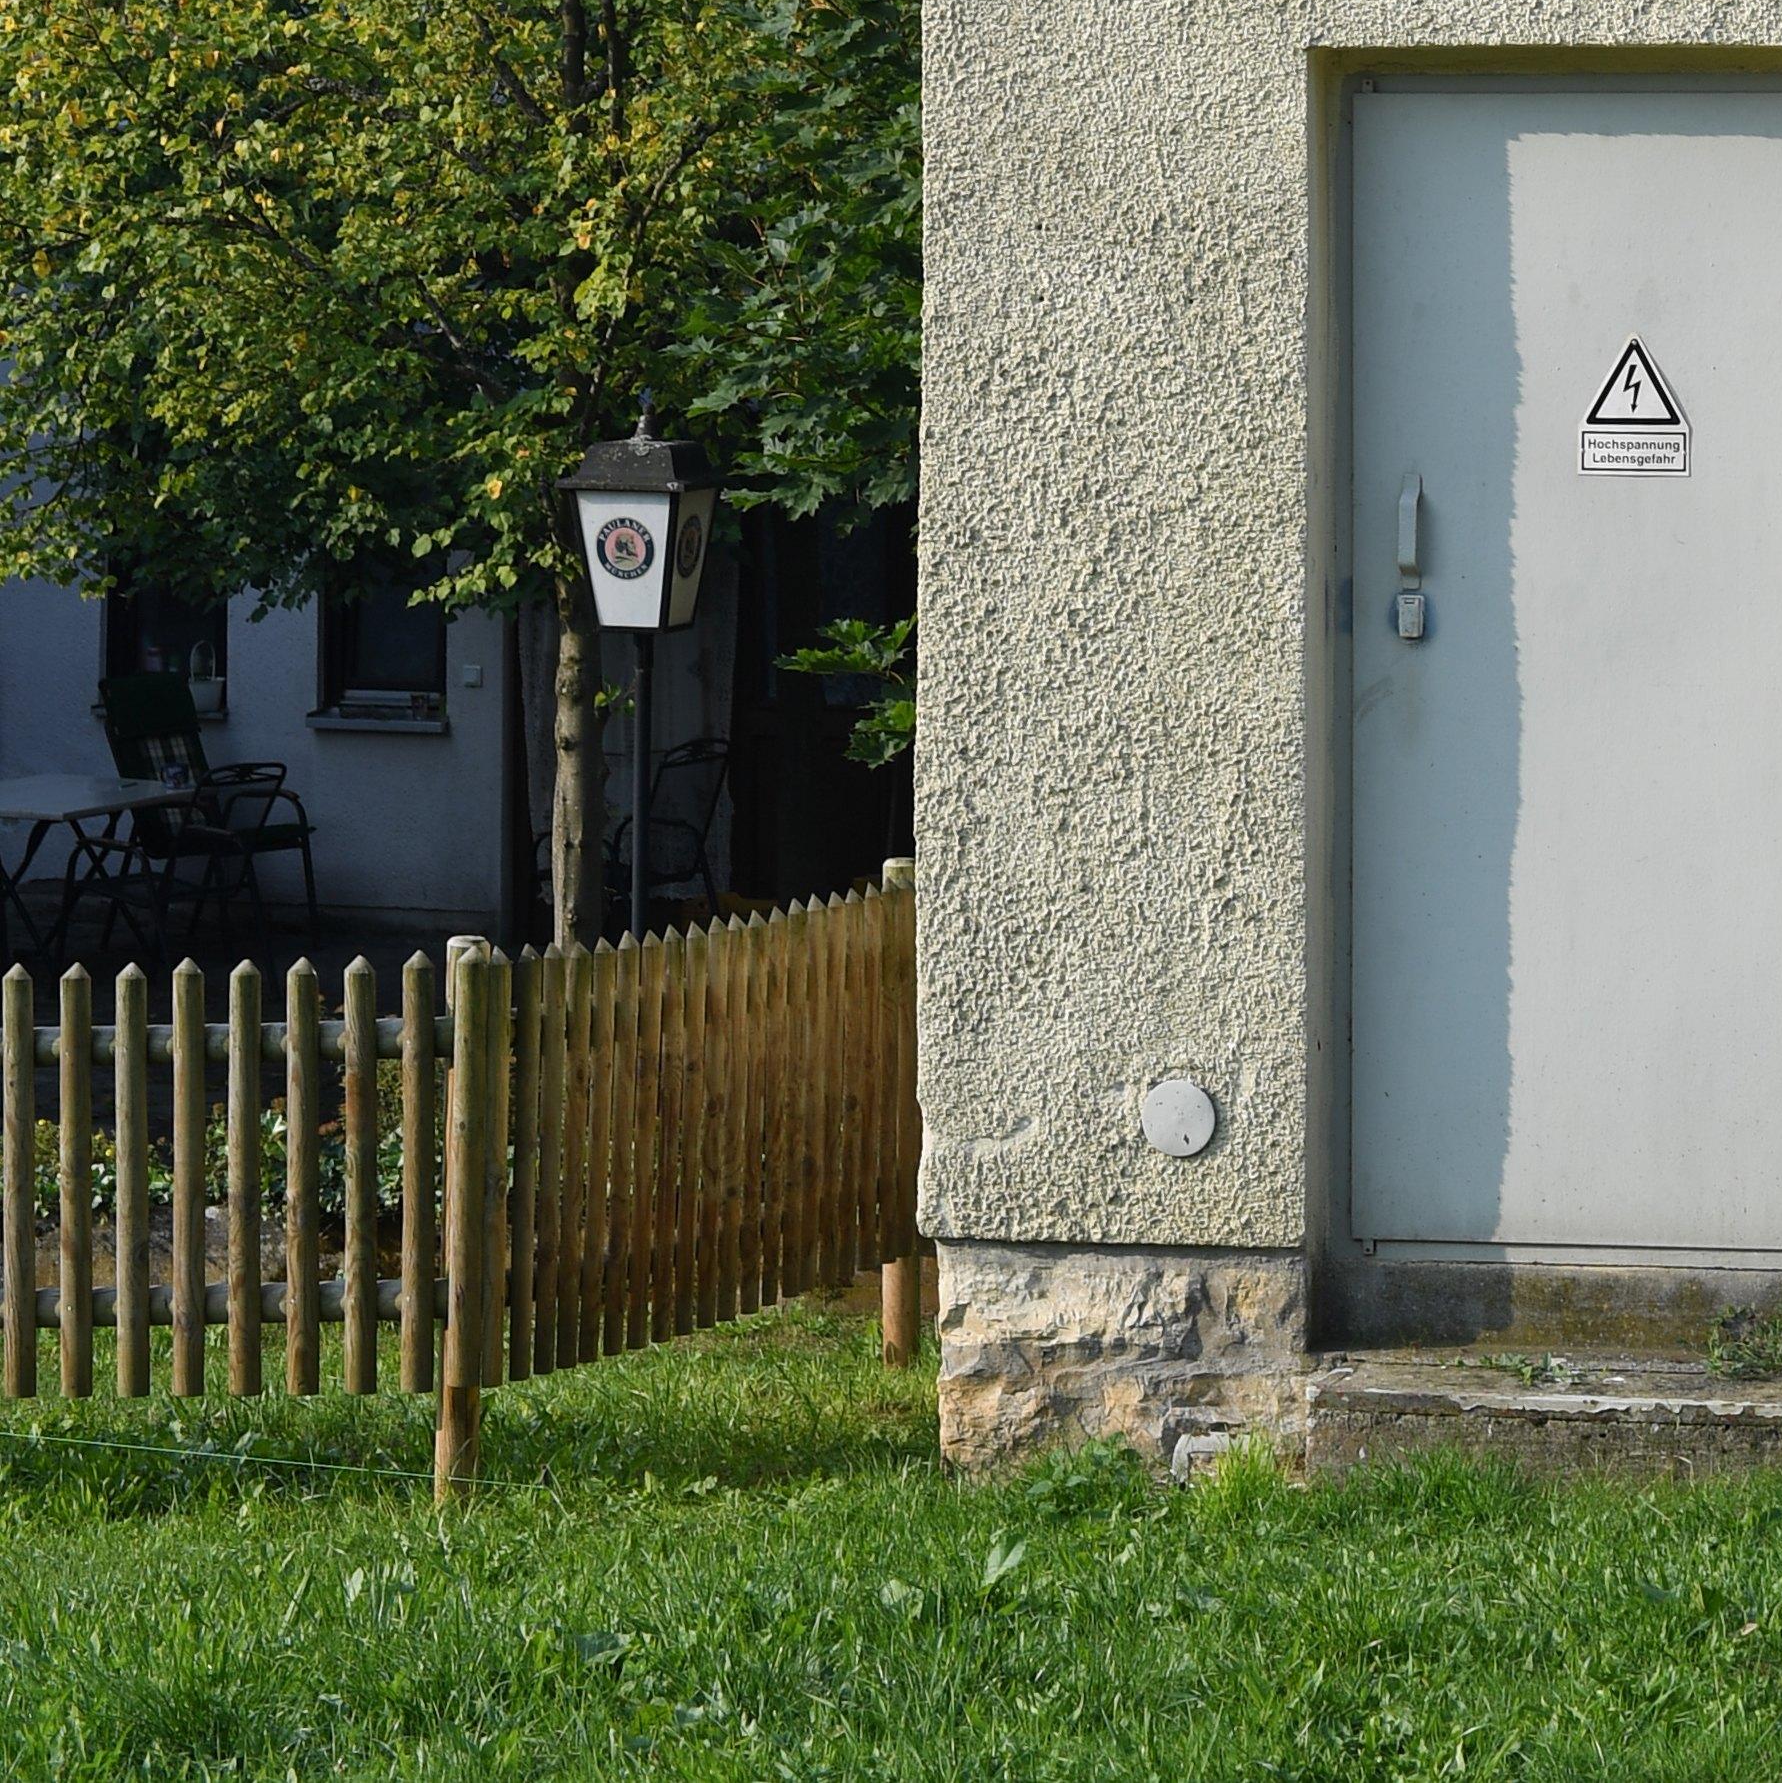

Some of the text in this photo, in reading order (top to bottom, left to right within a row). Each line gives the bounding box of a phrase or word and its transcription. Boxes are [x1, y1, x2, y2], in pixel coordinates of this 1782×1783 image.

[1587, 438, 1680, 453] Hochspannung
[1592, 453, 1676, 467] Lebensgefahr
[599, 519, 650, 541] PAULANER
